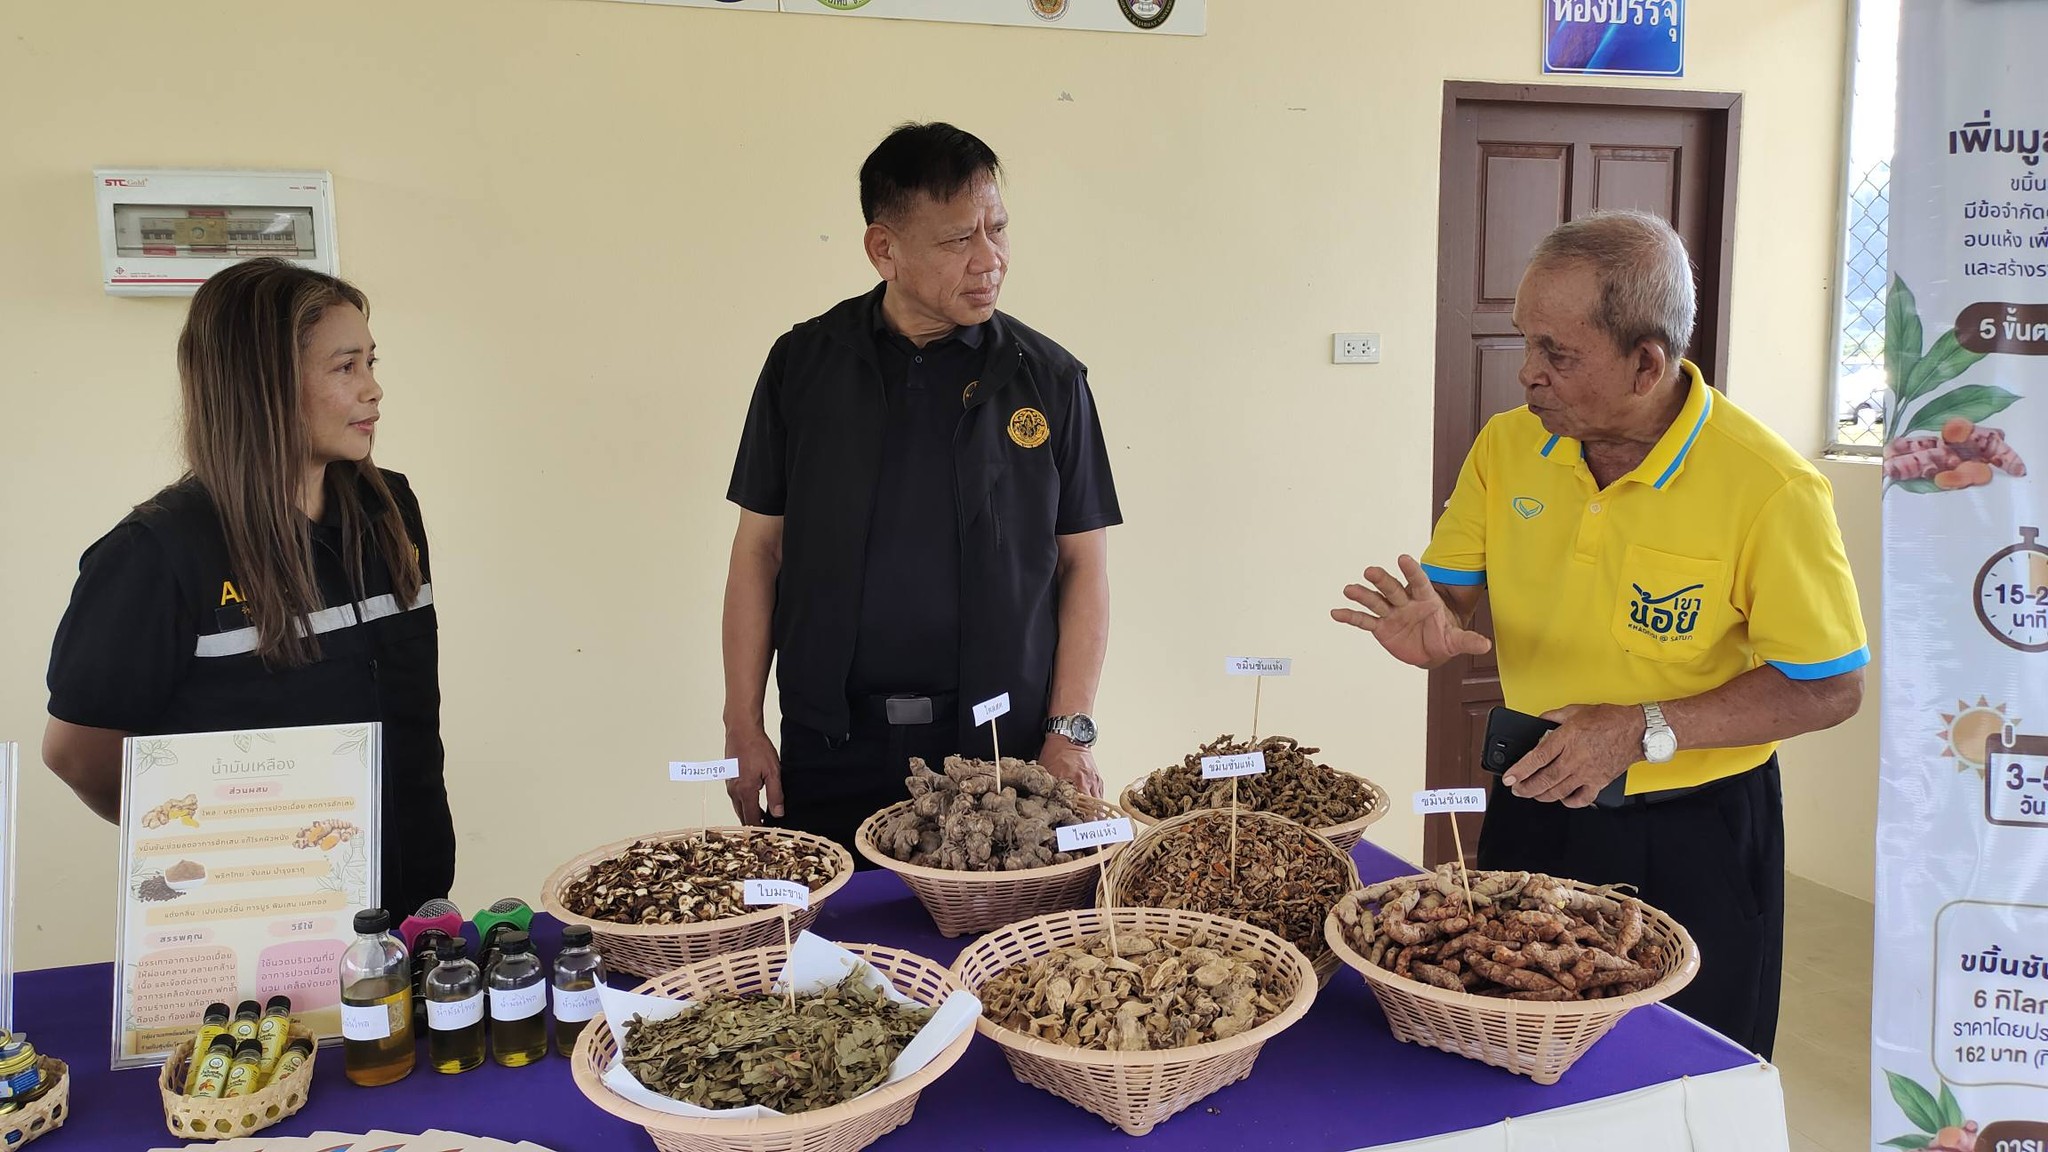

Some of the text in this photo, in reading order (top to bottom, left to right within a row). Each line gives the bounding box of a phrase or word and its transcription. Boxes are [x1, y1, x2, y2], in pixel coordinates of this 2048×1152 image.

[105, 178, 127, 187] STC
[2011, 171, 2048, 191] ขมิ้น
[1964, 200, 2048, 220] มีข้อจำกัด
[1964, 229, 2022, 248] อบแห้ง
[1979, 318, 1996, 340] 5
[1630, 589, 1699, 634] น้อย
[1674, 597, 1701, 611] เขา
[2012, 609, 2047, 629] นาที
[211, 757, 296, 775] น้ำมันเหลือง
[680, 764, 726, 778] ผิวมะกรูด
[228, 785, 269, 795] ส่วนผสม
[2020, 794, 2046, 815] วัน
[1072, 823, 1117, 841] ไพลแห้ง
[160, 932, 203, 943] สรรพคุณ
[1973, 989, 1987, 1009] 6
[1955, 1046, 1986, 1063] 162
[1991, 1047, 2027, 1064] บาท
